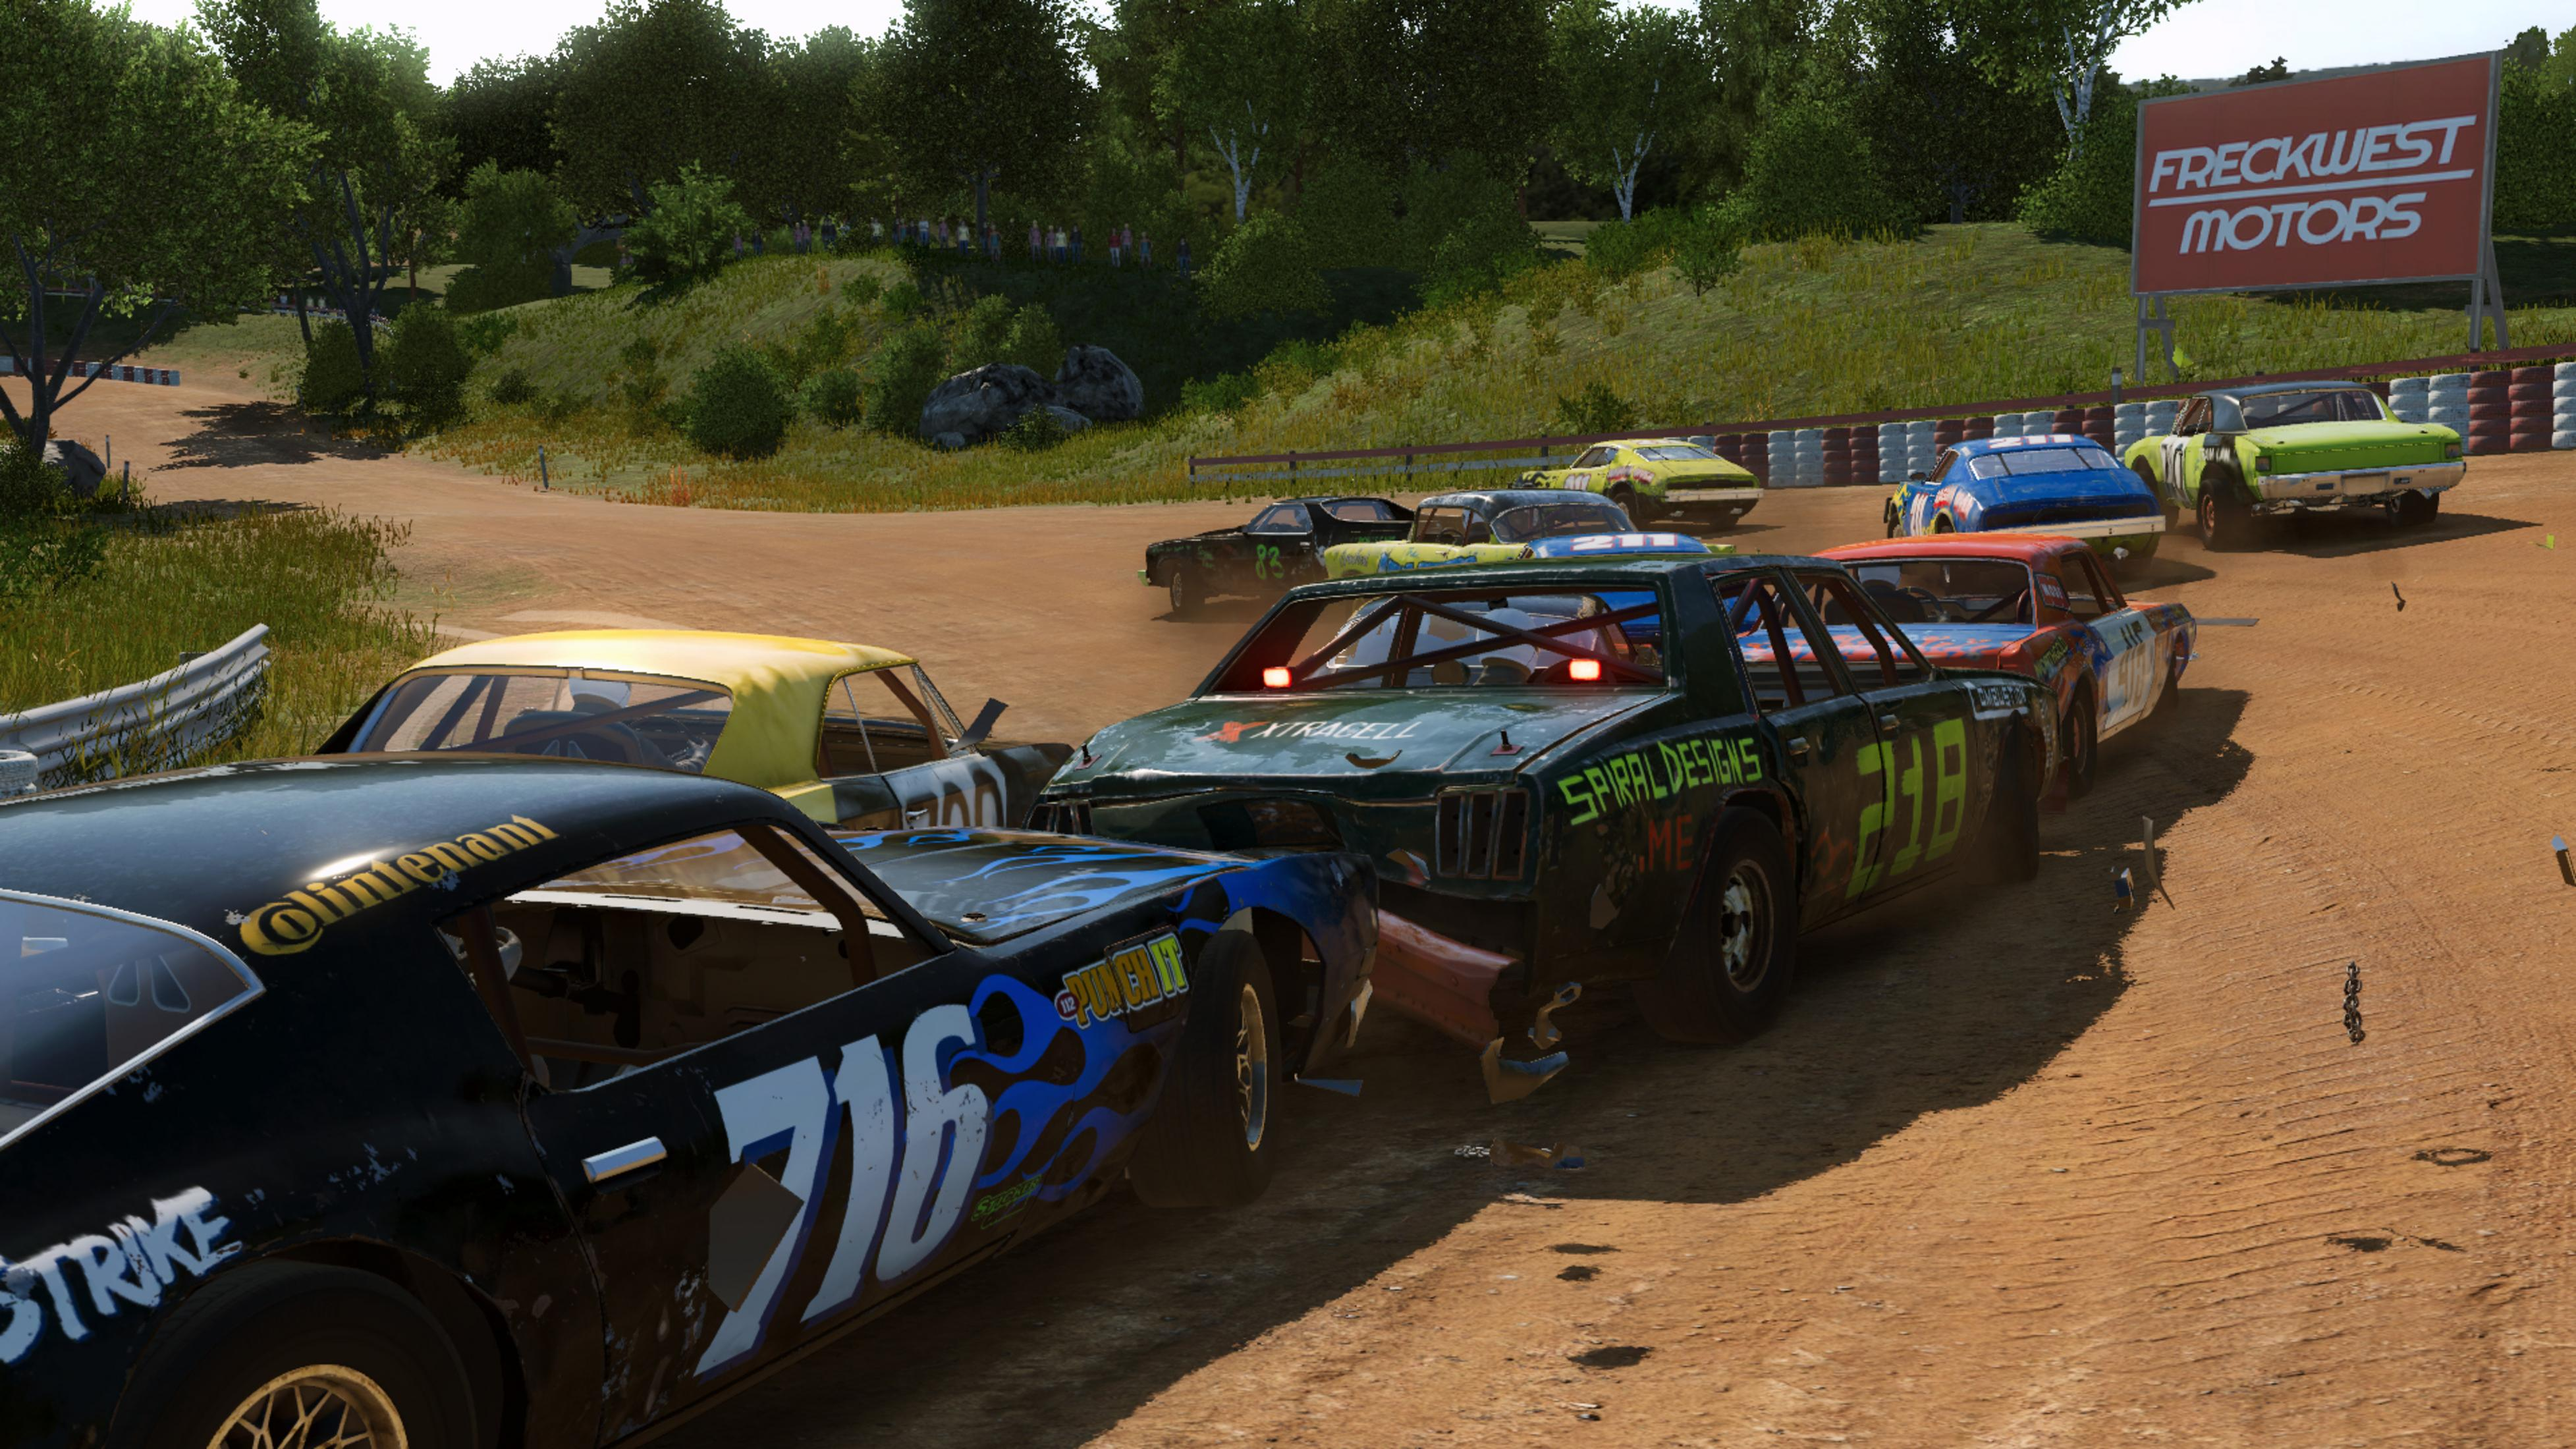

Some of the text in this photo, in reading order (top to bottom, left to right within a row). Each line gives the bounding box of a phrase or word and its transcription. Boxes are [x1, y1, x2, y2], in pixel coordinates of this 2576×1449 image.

[2149, 115, 2477, 193] FRECKWEST
[2179, 192, 2427, 255] MOTORS
[1255, 544, 1284, 580] 83
[1570, 533, 1678, 551] 211
[1249, 721, 1423, 740] XTRACELL
[1064, 946, 1161, 1027] PUNCH
[1148, 935, 1187, 995] IT
[694, 1004, 989, 1377] 716
